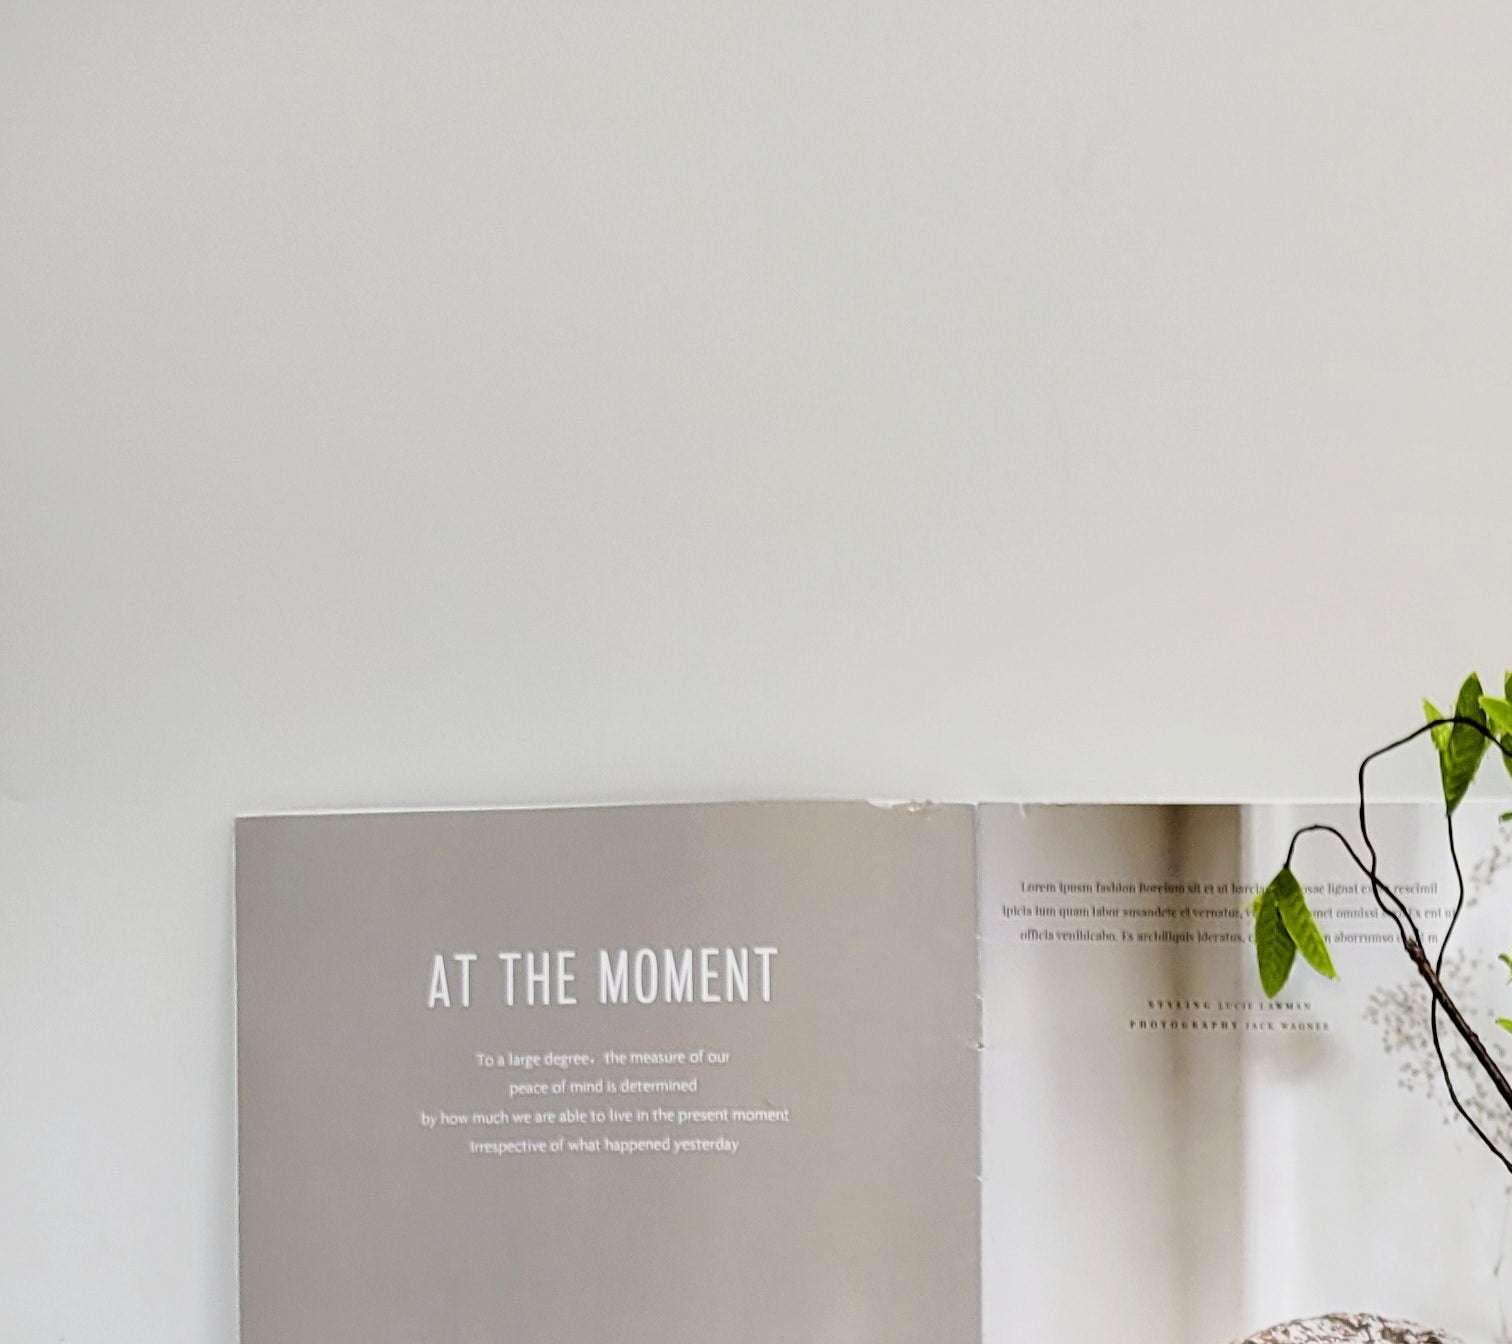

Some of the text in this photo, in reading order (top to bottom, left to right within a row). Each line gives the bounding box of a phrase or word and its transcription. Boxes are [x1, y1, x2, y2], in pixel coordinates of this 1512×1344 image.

[1020, 881, 1056, 894] Lorem
[427, 946, 778, 1008] AT THE MOMENT
[1130, 1020, 1238, 1030] PHOTOGRAPHY
[476, 1053, 494, 1067] To
[509, 1052, 541, 1070] large
[604, 1050, 627, 1065] the
[630, 1052, 686, 1065] measure
[689, 1050, 704, 1064] of
[708, 1052, 731, 1064] our
[509, 1082, 549, 1097] peace
[552, 1079, 567, 1094] of
[570, 1079, 603, 1094] mind
[620, 1078, 698, 1093] determined
[421, 1107, 791, 1129] by how much we are able to live in the present moment
[550, 1138, 565, 1153] of
[568, 1137, 600, 1151] what
[604, 1136, 670, 1153] happened
[673, 1137, 740, 1154] yesterday
